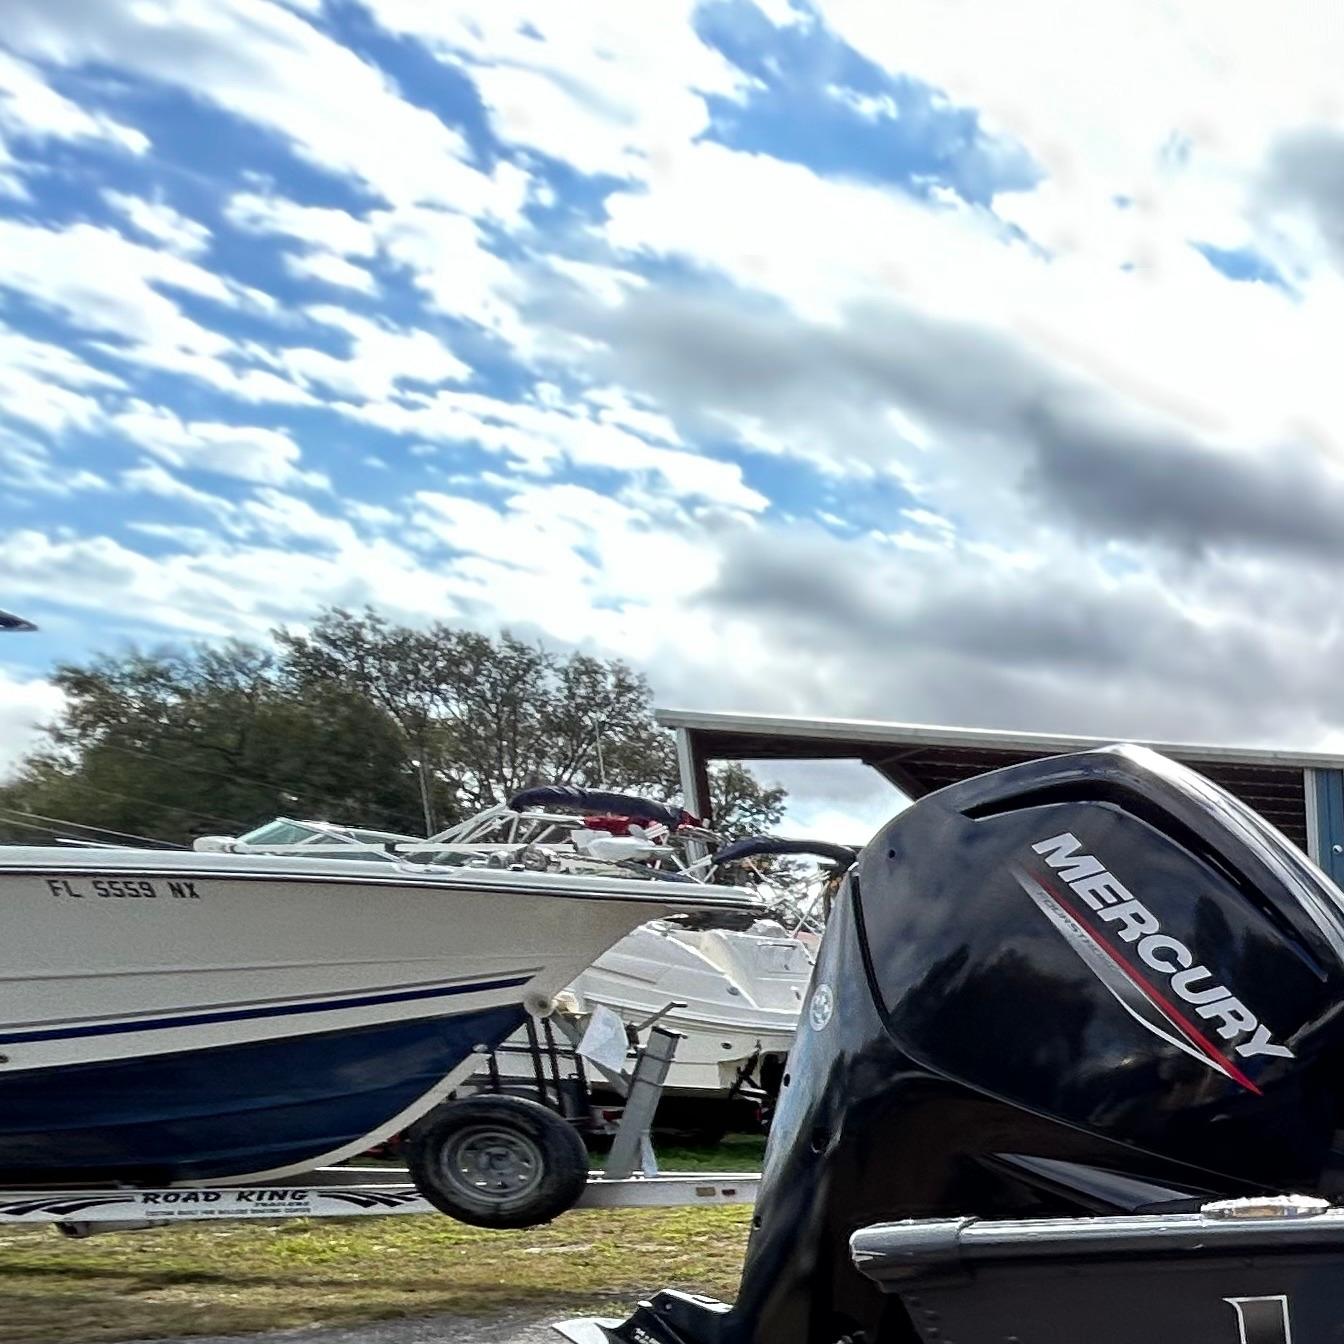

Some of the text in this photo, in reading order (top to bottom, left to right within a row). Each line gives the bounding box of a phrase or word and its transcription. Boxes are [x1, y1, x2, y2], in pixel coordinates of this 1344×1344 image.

[45, 879, 200, 899] FL 5559 NX
[1032, 832, 1297, 1059] MERCURY
[141, 1189, 308, 1204] ROAD KING
